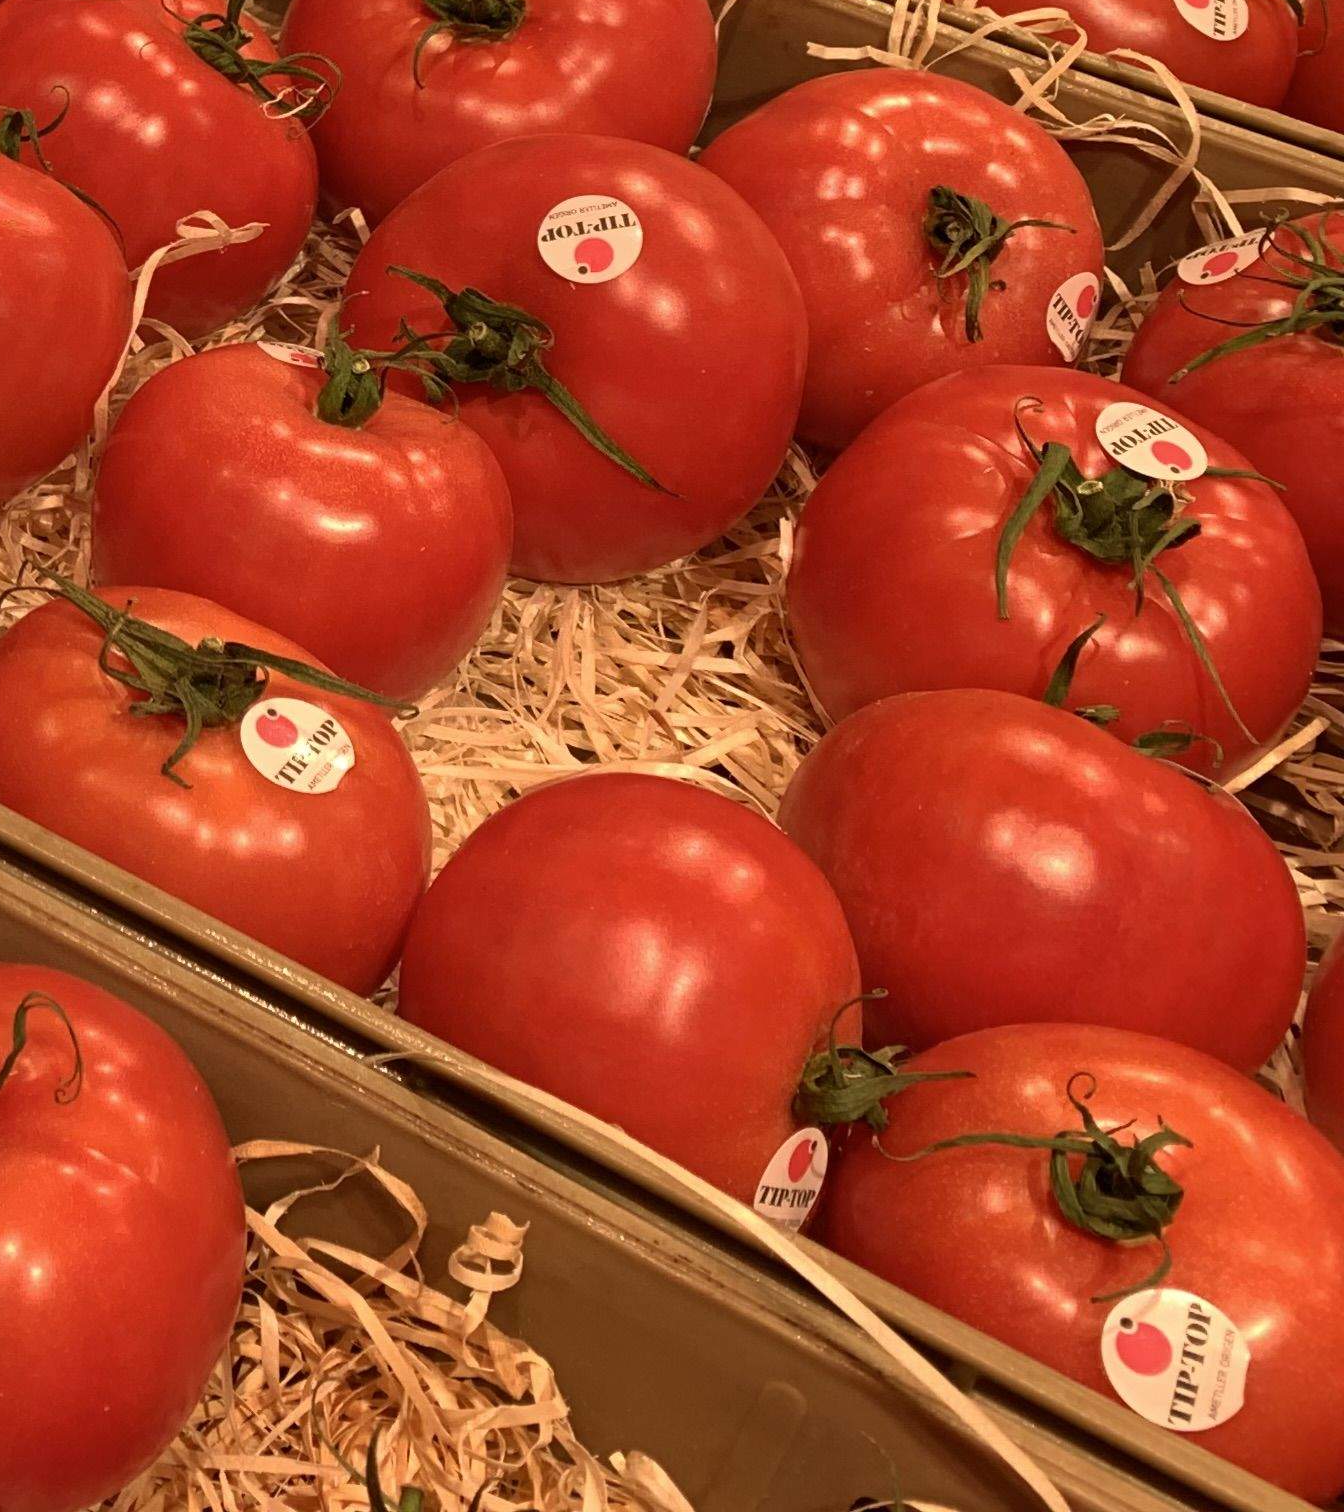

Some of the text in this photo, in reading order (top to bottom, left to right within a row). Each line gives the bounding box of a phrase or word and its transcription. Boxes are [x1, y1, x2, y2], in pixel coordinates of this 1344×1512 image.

[540, 212, 638, 243] TIP-TOP
[1051, 292, 1085, 345] TIP-TO
[1109, 417, 1180, 457] TIP-TOP
[759, 1185, 818, 1209] TIP-TOP
[1167, 1301, 1212, 1425] TIP-TOP
